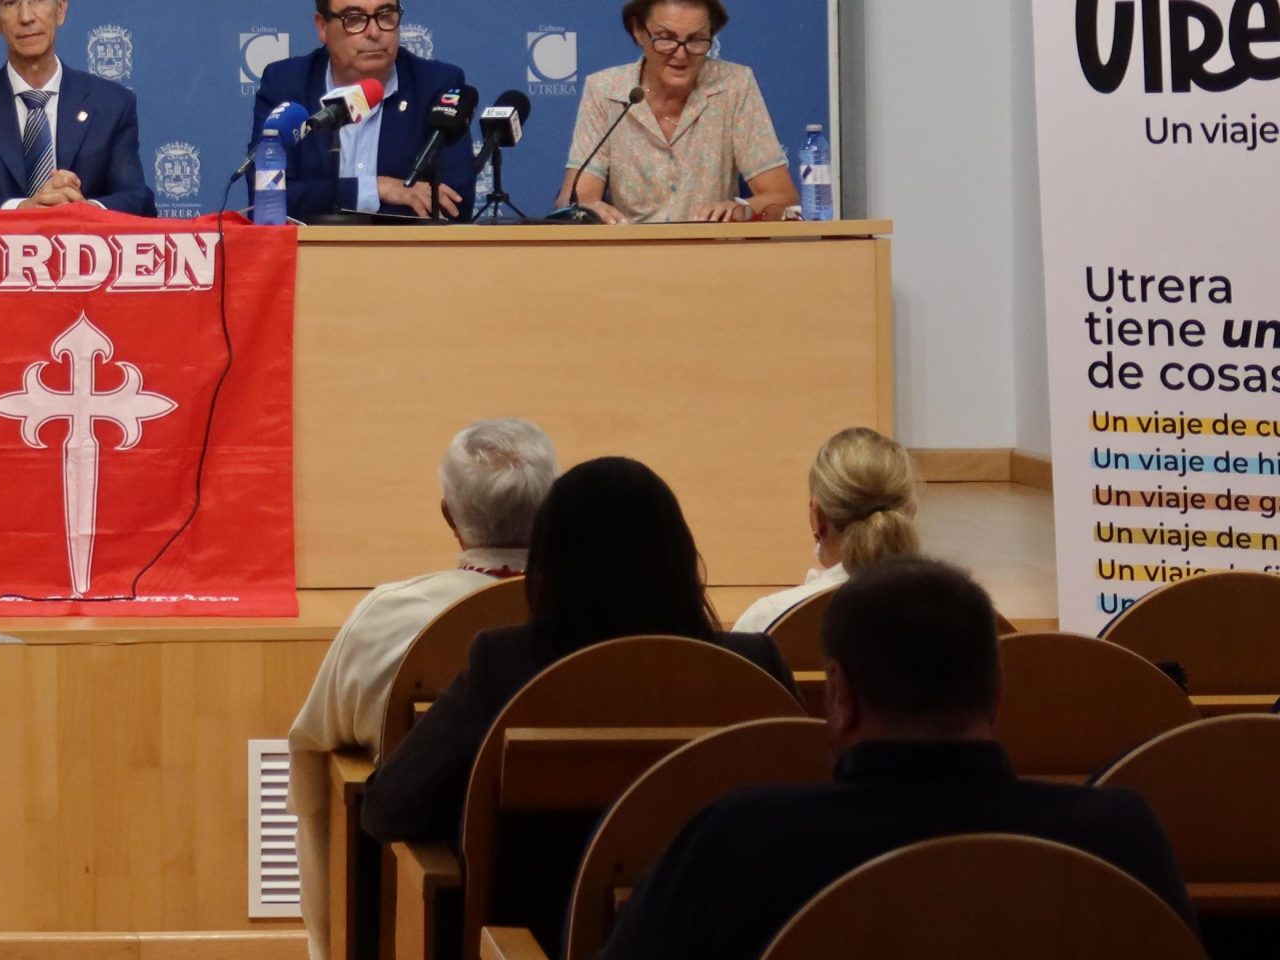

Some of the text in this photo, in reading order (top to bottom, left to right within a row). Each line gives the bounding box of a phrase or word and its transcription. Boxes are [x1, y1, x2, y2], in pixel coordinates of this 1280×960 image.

[528, 84, 578, 95] UTRERA
[1145, 113, 1279, 151] Un viaje
[1085, 266, 1233, 304] Utrera
[1084, 306, 1207, 347] tiene
[1088, 351, 1144, 390] de
[1092, 410, 1128, 433] Un
[1136, 410, 1203, 439] viaje
[1212, 413, 1247, 436] de
[1093, 447, 1130, 470] Un
[1138, 448, 1205, 477] viaje
[1213, 450, 1249, 474] de
[1095, 484, 1131, 507] Un
[1140, 485, 1206, 514] viaje
[1215, 488, 1250, 511] de
[1096, 521, 1133, 544] Un
[1142, 522, 1208, 552] viaje
[1216, 525, 1252, 549] de
[1097, 558, 1135, 581] Un
